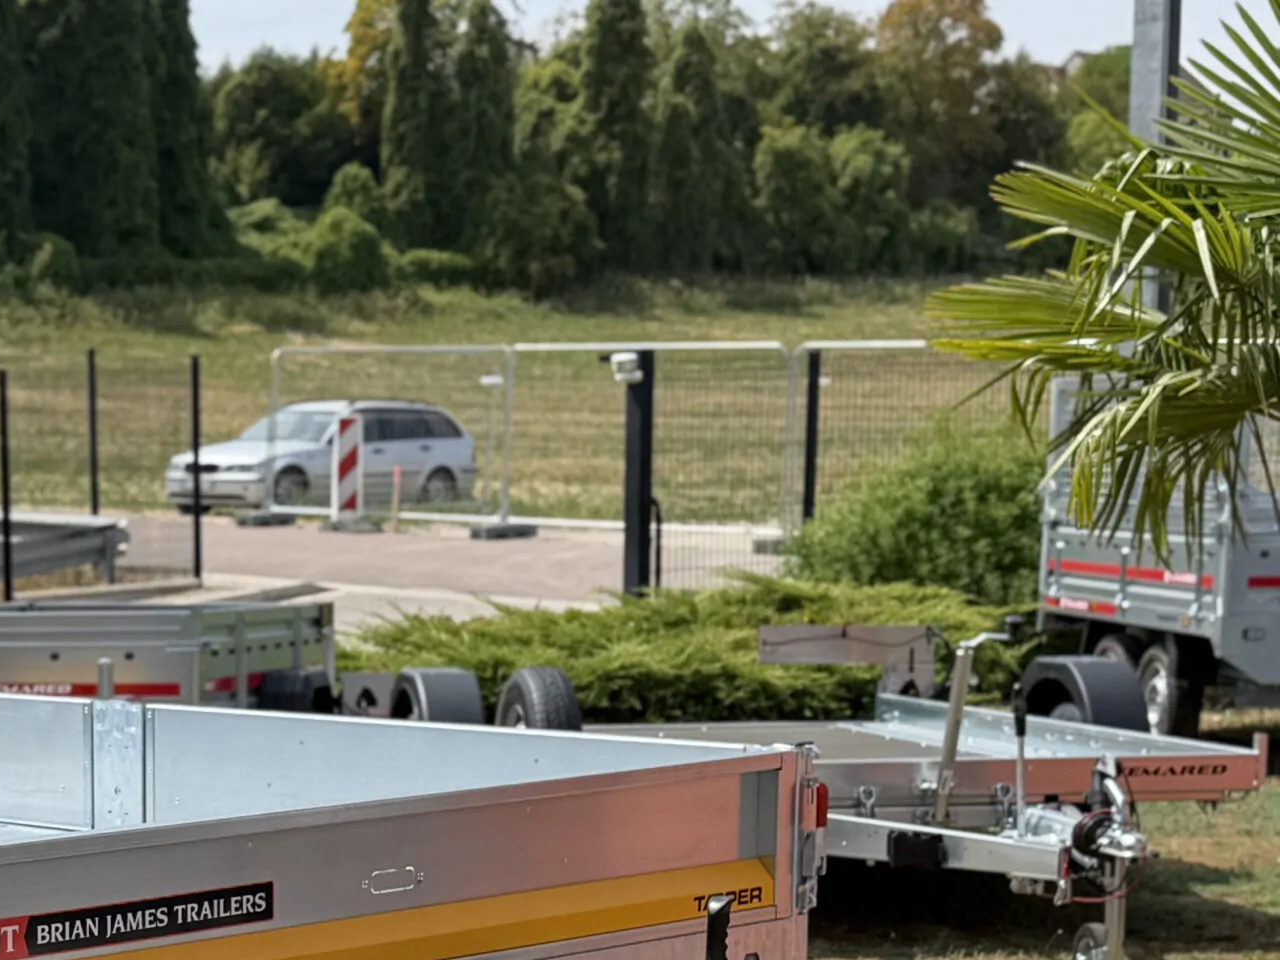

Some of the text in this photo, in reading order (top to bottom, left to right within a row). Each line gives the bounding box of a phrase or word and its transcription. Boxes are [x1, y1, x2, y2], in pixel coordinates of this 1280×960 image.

[1119, 764, 1228, 777] EMARED
[693, 886, 763, 912] TPER
[36, 917, 100, 945] BRIAN
[105, 907, 169, 938] JAMES
[173, 892, 267, 924] TRAILERS
